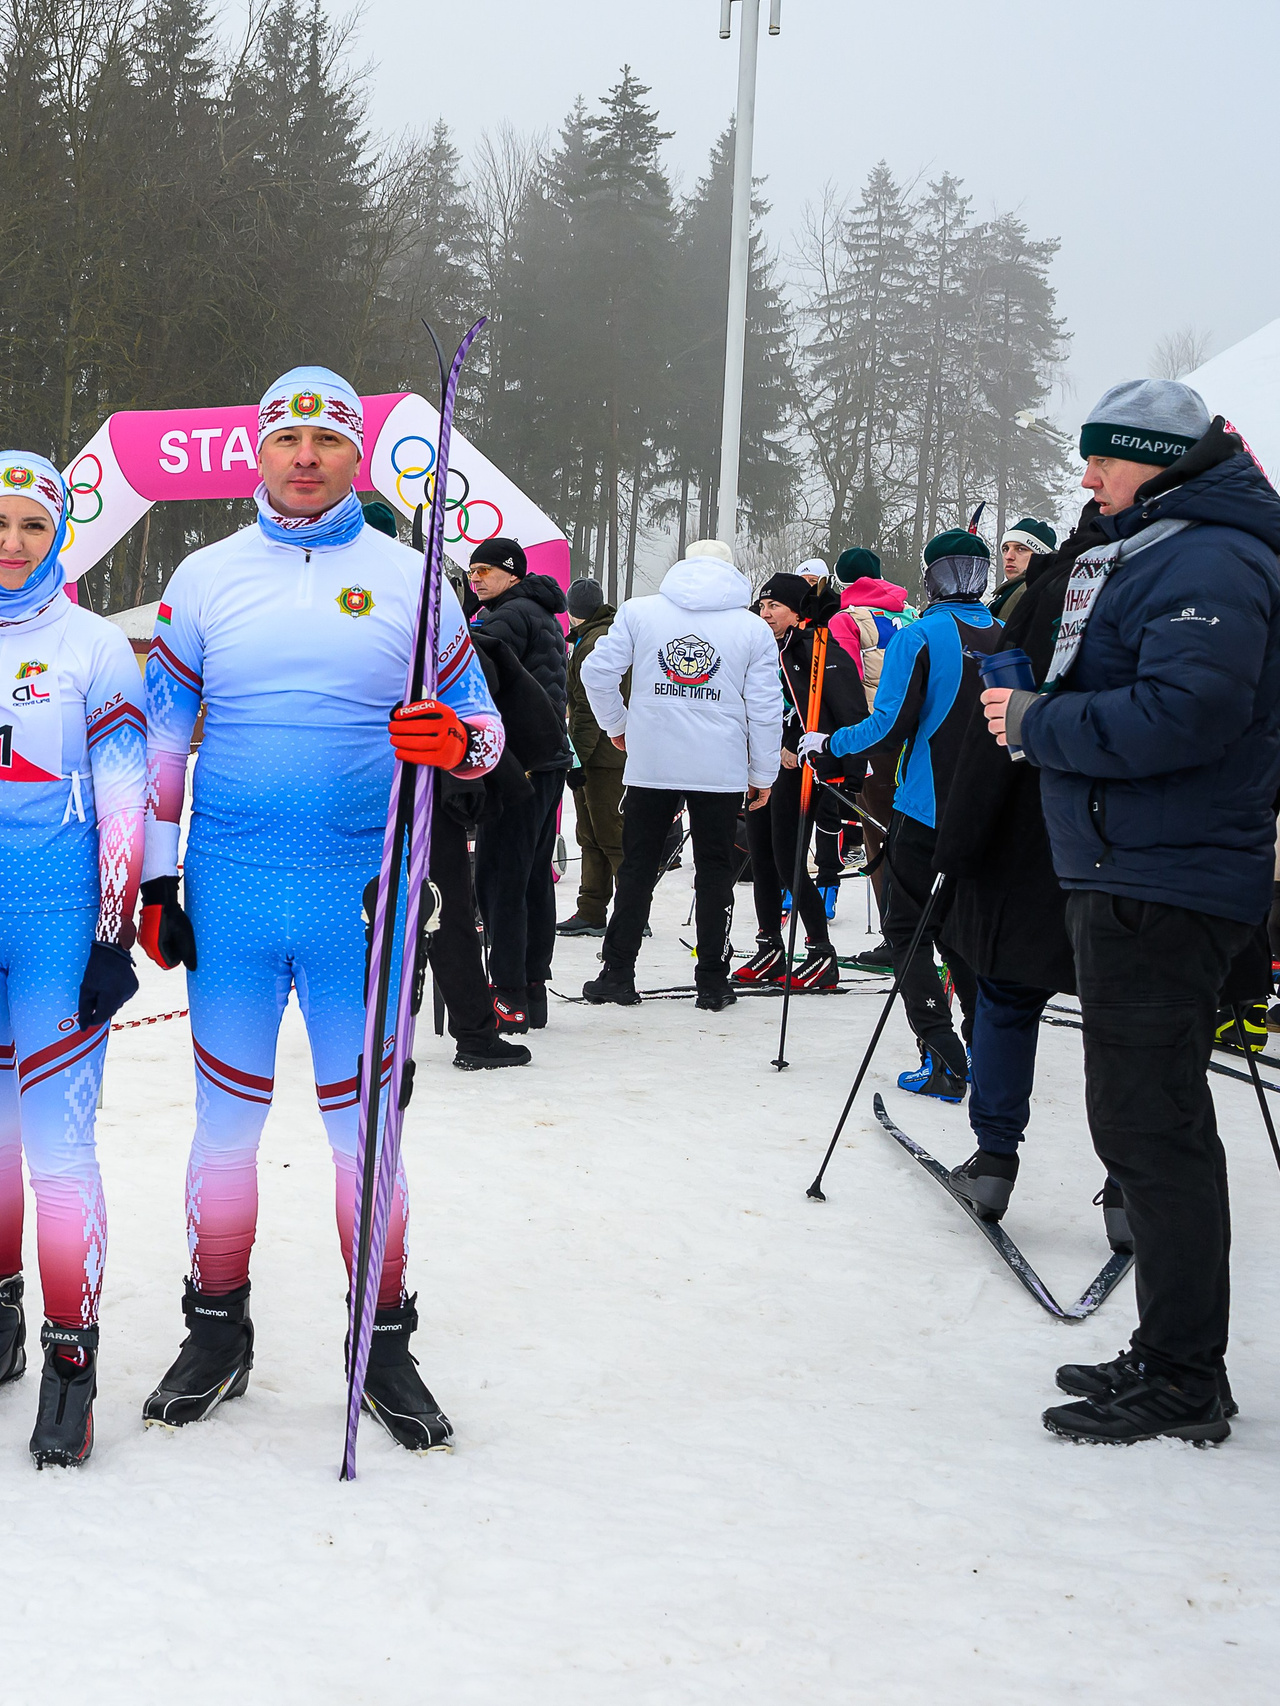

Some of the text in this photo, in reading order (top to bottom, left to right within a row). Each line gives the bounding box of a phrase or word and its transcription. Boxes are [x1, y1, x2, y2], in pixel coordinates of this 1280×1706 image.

[438, 625, 466, 664] ORAZ
[85, 692, 124, 725] ORAZ
[654, 683, 722, 701] БЕЛЫЕ ТИГРЫ
